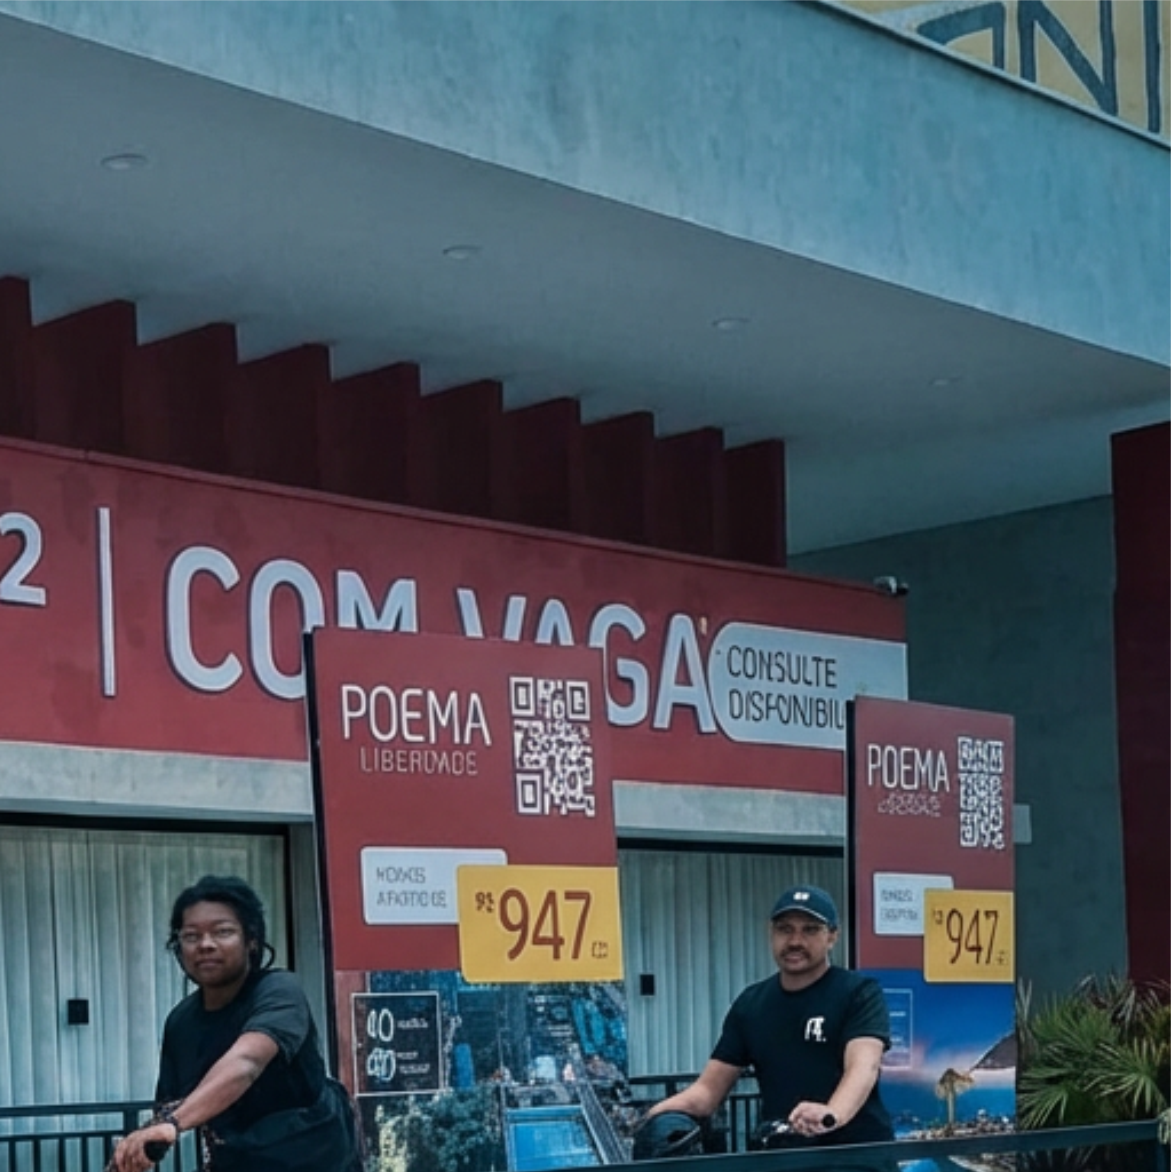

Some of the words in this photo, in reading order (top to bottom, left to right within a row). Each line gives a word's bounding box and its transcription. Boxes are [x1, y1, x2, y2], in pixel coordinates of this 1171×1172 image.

[456, 587, 717, 734] GA
[728, 645, 838, 688] CONSULTE
[342, 684, 491, 746] POEMA
[868, 743, 950, 793] POEMA
[499, 888, 592, 961] 947
[946, 908, 999, 965] 947
